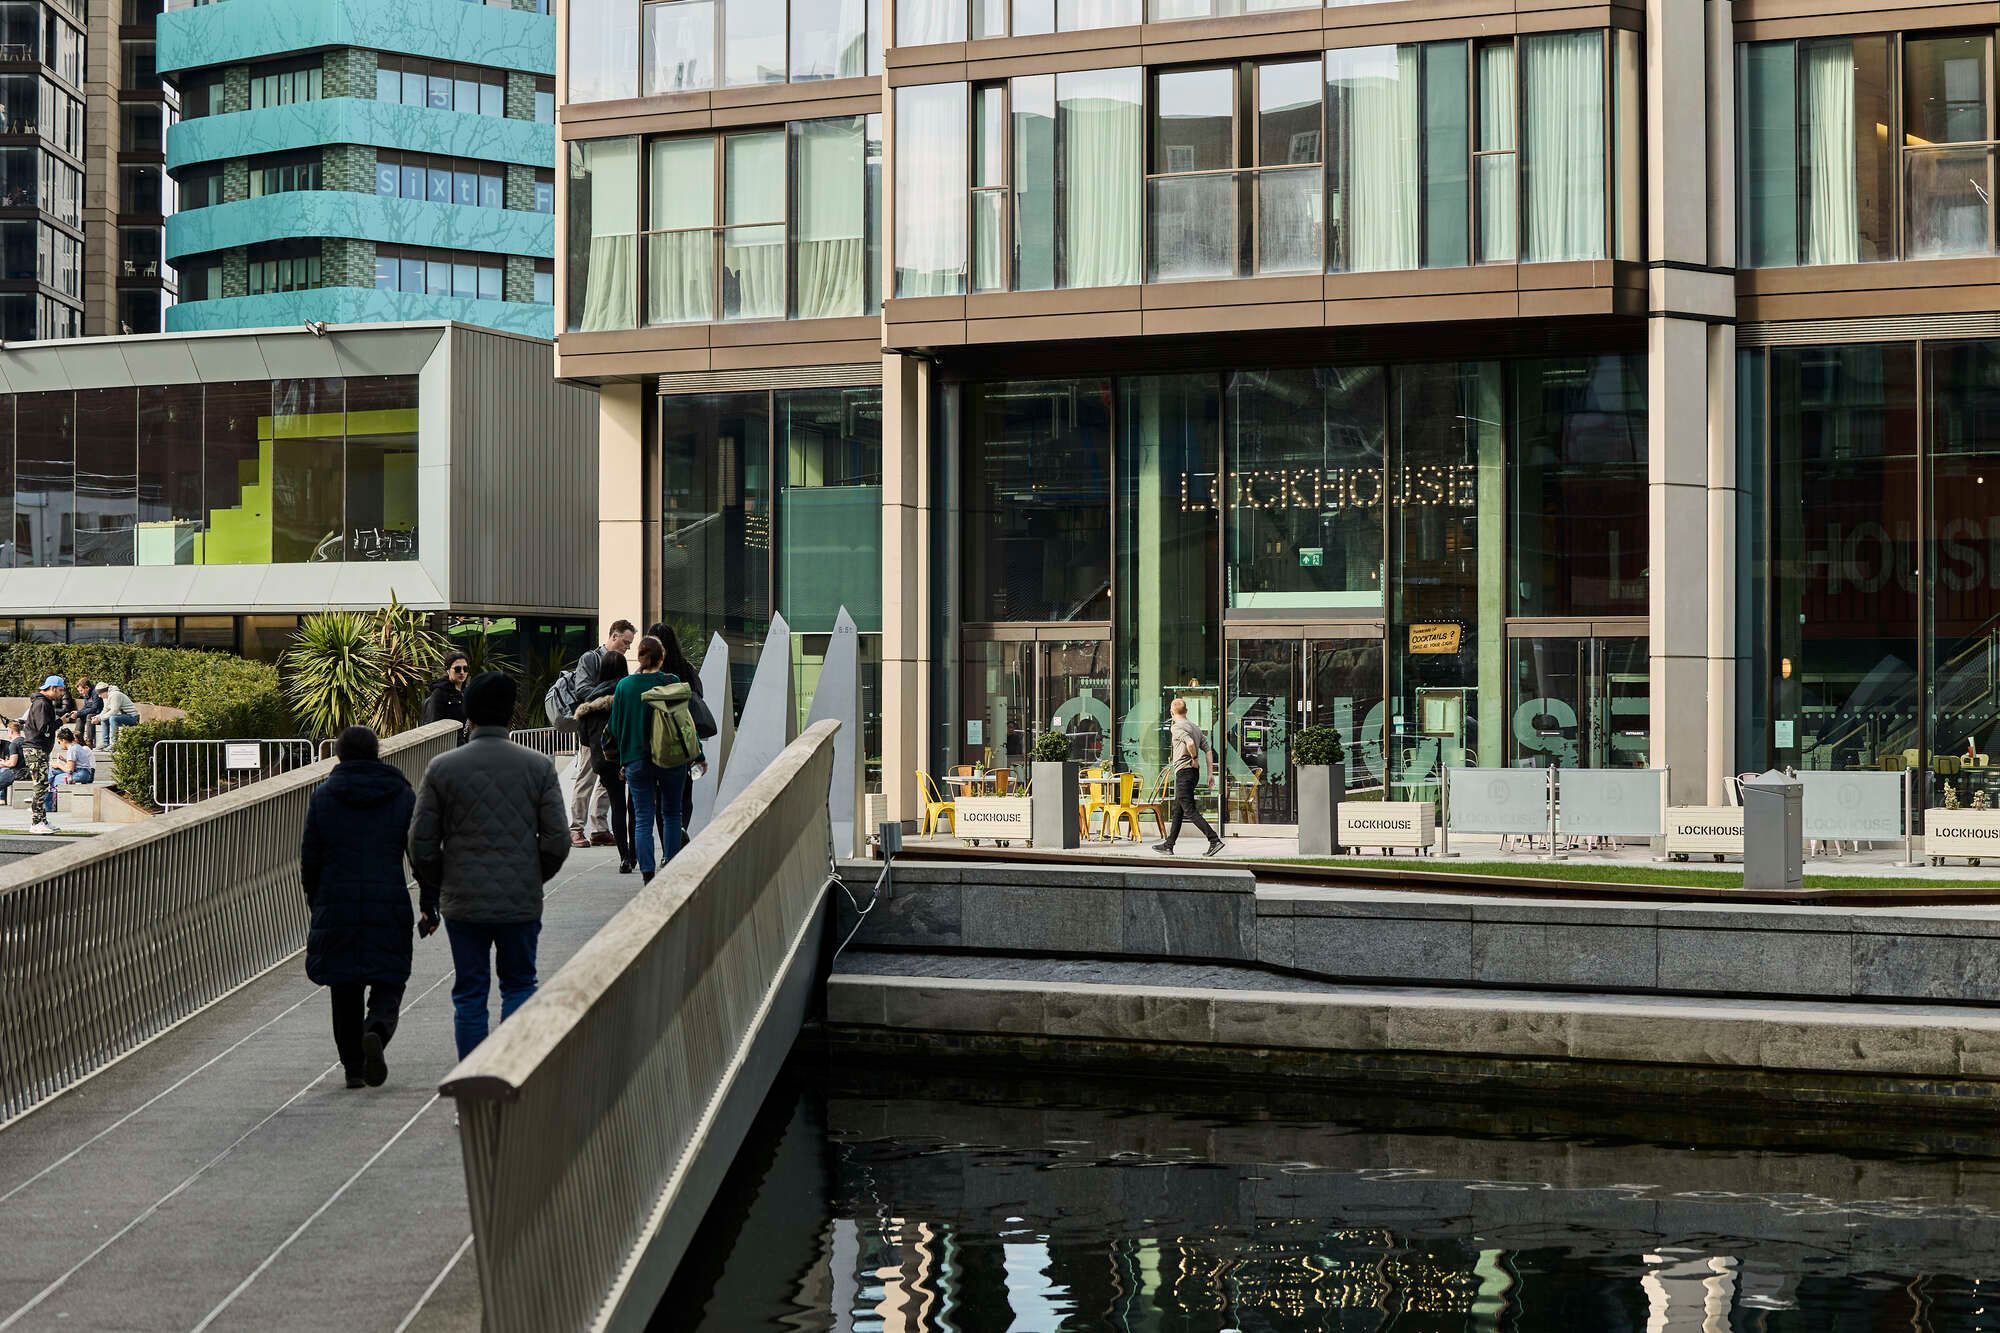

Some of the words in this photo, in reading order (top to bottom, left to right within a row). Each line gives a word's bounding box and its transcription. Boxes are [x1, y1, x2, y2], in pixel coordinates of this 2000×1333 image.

[380, 169, 497, 206] Sixth
[1179, 464, 1475, 513] LOCKHOUSE
[1800, 515, 2000, 597] HOUS
[1412, 632, 1447, 644] COCKTAILS
[963, 812, 1021, 823] LOCKHOUSE
[1348, 819, 1411, 831] LOCKHOUSE
